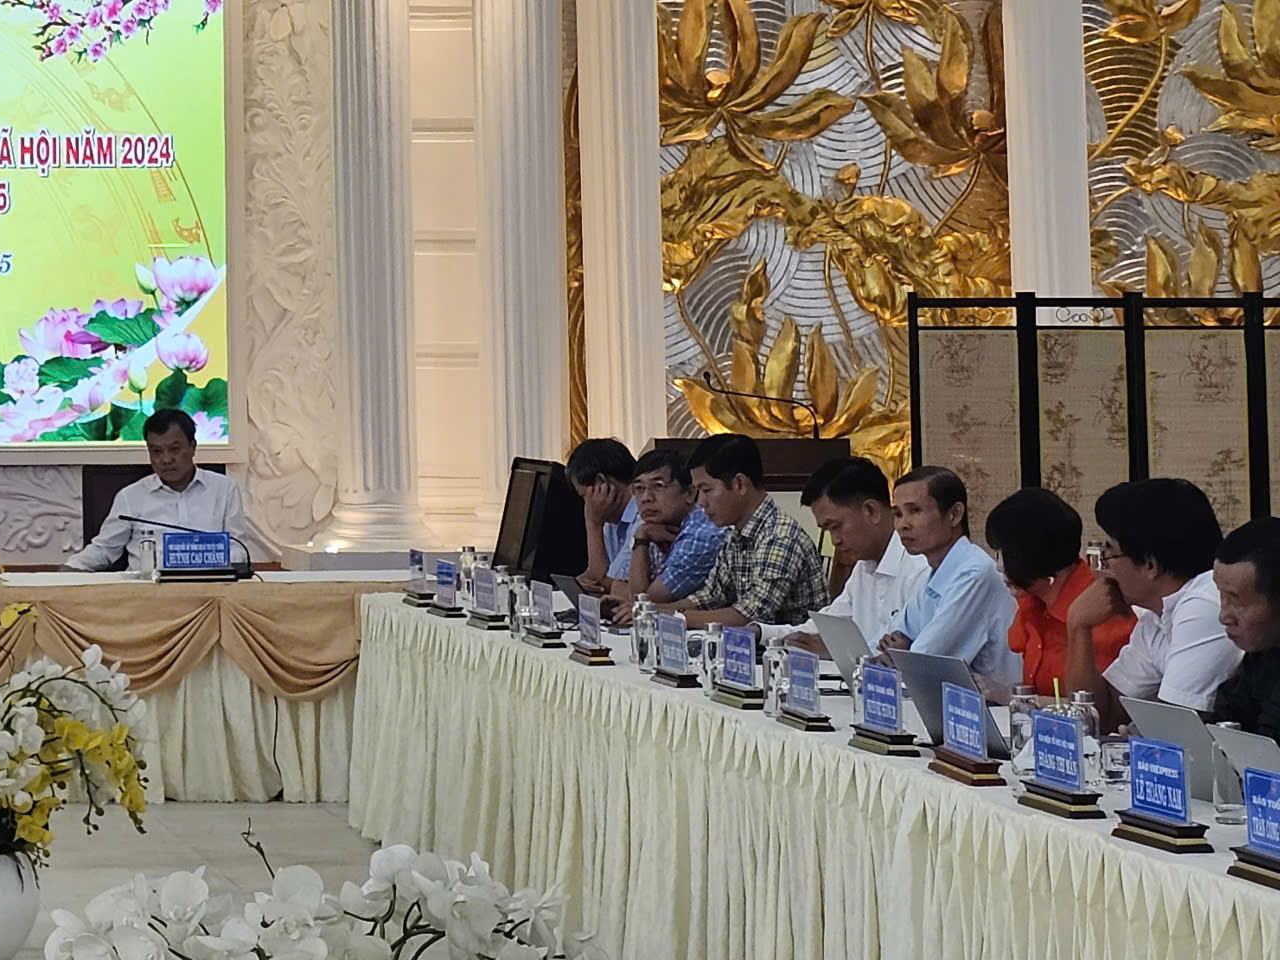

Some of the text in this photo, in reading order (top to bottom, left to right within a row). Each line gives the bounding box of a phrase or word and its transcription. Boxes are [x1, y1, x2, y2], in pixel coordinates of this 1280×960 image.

[20, 129, 58, 175] HỘI
[65, 128, 114, 166] NĂM
[120, 136, 172, 166] 2024
